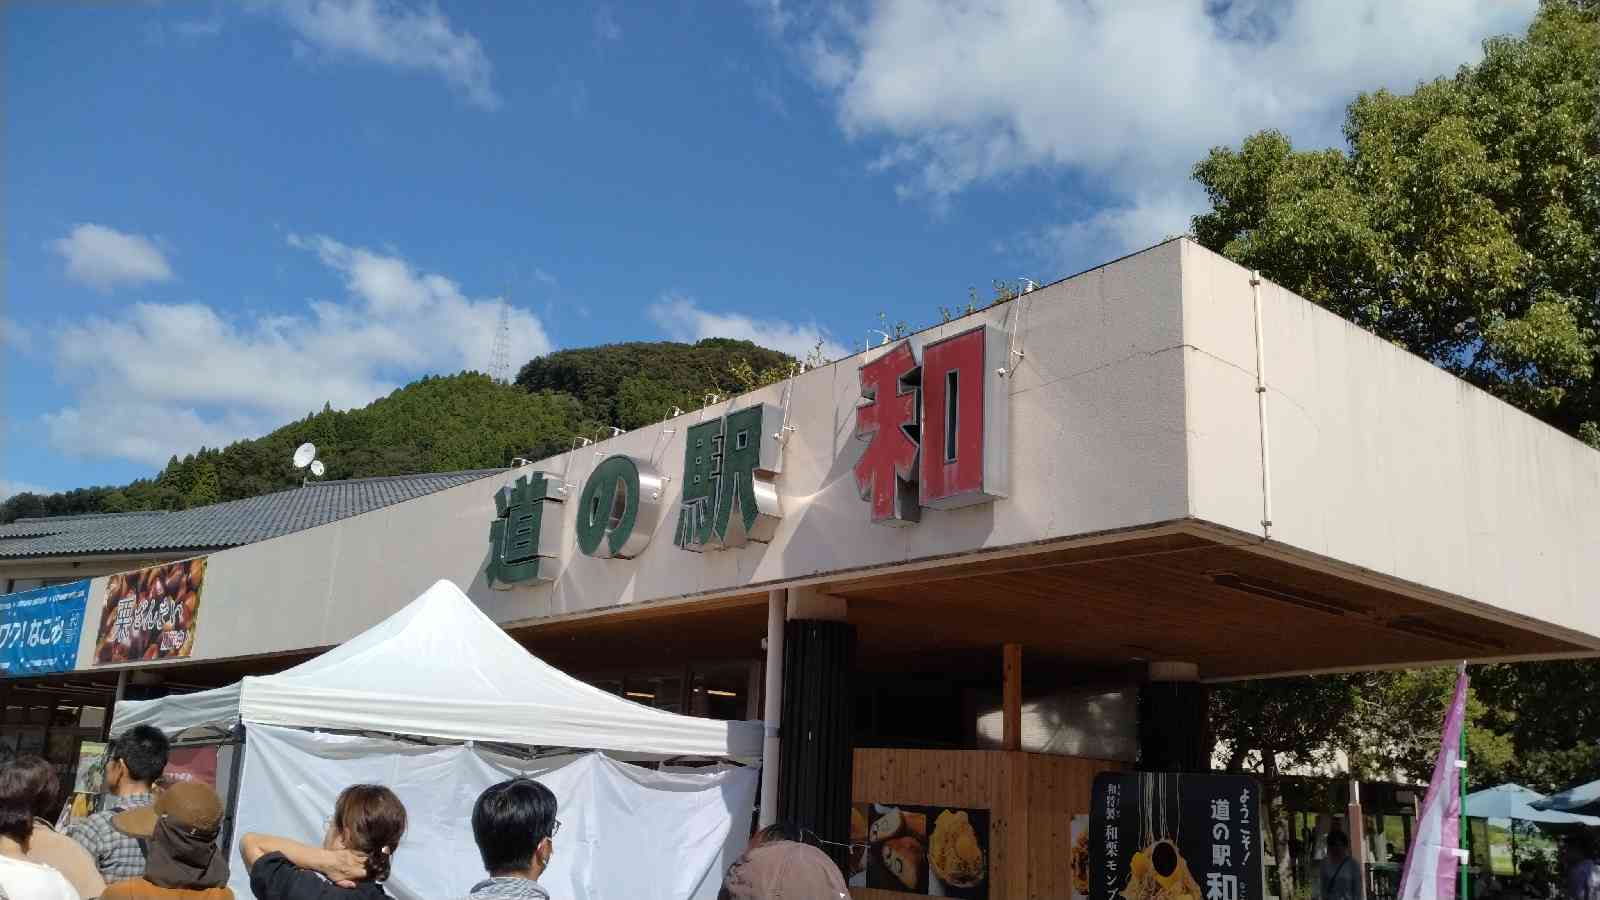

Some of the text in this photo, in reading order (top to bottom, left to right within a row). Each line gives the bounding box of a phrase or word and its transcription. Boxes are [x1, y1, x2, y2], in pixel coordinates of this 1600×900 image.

[486, 324, 990, 588] 道の駅 和
[1210, 799, 1232, 867] 道の駅
[1239, 788, 1251, 866] ようこそ!
